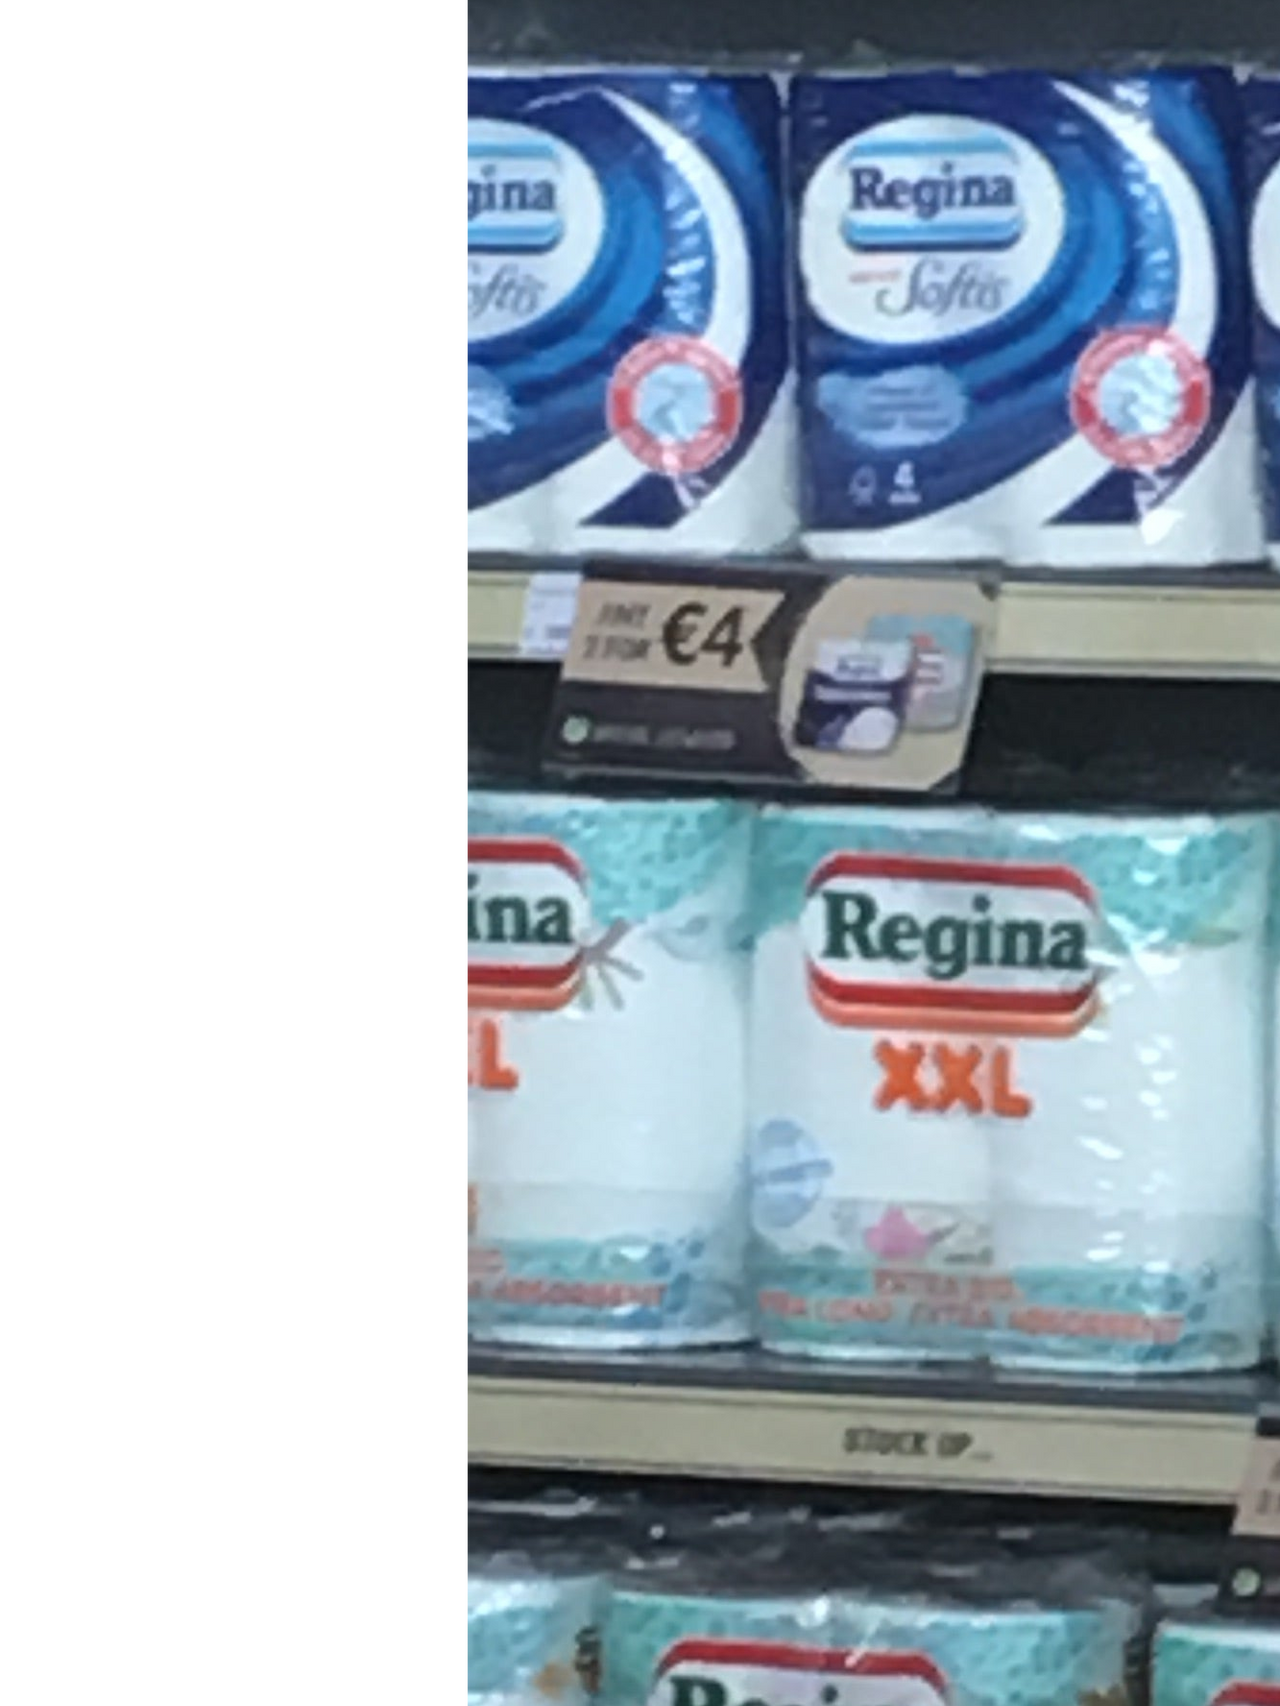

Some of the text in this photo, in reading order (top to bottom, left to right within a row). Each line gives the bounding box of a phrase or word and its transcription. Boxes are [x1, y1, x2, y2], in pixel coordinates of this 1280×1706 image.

[465, 163, 556, 222] gina
[849, 162, 1016, 220] Regina
[661, 601, 747, 669] €4
[822, 889, 1090, 981] Regina
[874, 1039, 1033, 1118] XXL
[843, 1427, 926, 1458] STOCK
